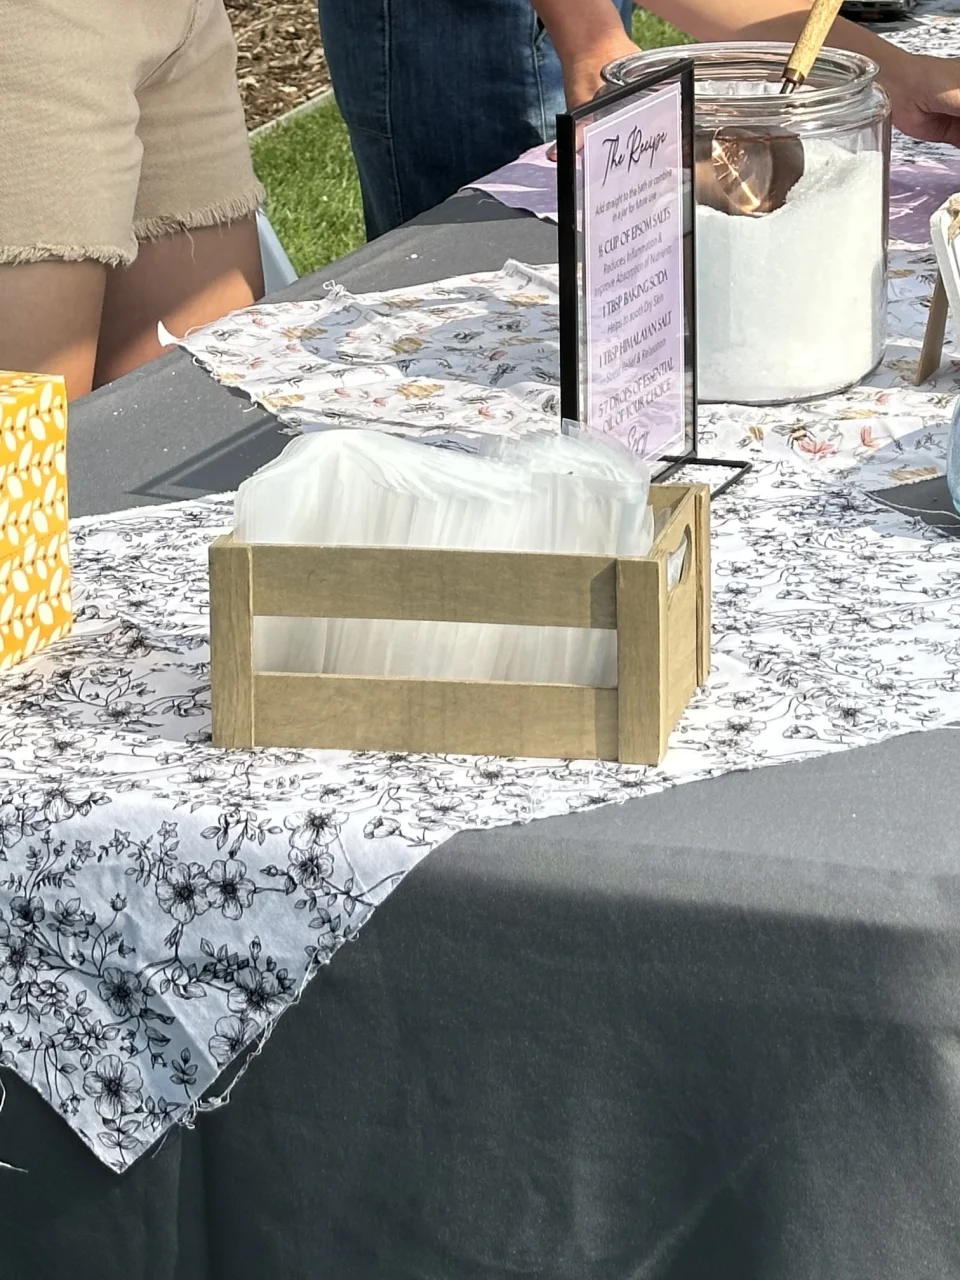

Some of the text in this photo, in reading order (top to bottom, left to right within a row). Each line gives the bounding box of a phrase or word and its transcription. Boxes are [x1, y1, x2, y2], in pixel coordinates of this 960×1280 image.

[602, 125, 668, 187] The Recipe
[604, 192, 623, 214] straight
[604, 235, 620, 254] CUP
[620, 228, 631, 246] OF
[631, 217, 652, 240] EPSOM
[653, 207, 671, 228] SALTS
[606, 295, 623, 316] TBSP
[623, 279, 649, 306] BAKING
[649, 269, 669, 290] SODA
[603, 345, 619, 366] TBSP
[619, 320, 657, 356] HIMALAYAN
[657, 310, 672, 331] SALT
[603, 377, 672, 434] OIL OF YOUR CHOICE
[609, 386, 632, 410] DROPS
[632, 377, 643, 394] OF
[643, 357, 674, 388] ESSENTIAL
